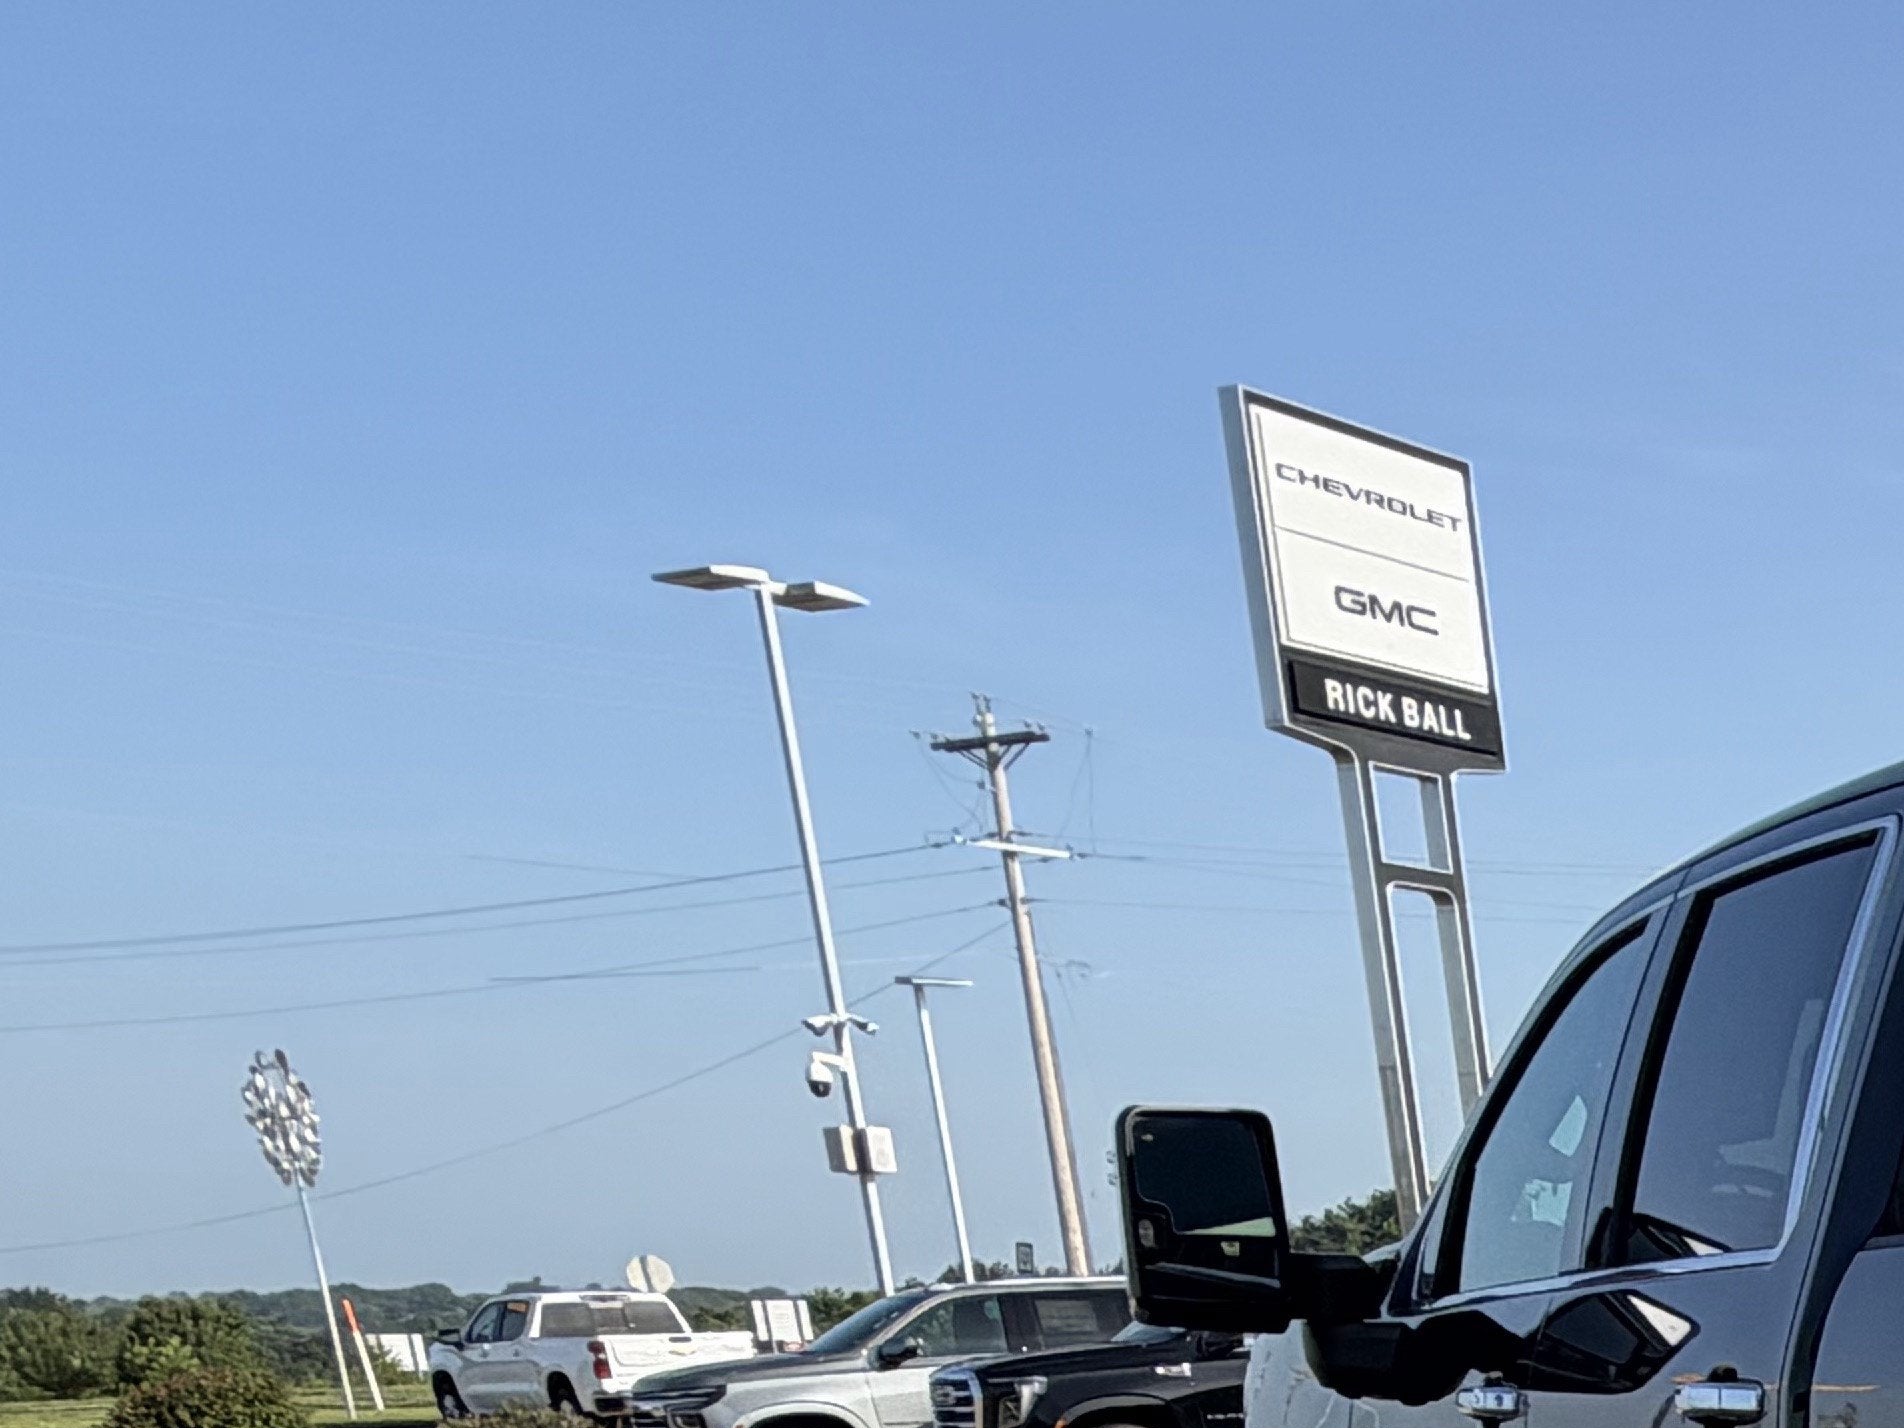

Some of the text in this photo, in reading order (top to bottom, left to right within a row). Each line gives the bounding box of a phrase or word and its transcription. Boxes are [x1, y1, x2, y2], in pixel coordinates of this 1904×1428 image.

[1275, 462, 1463, 533] CHEVROLET
[1334, 585, 1439, 636] GMC
[1324, 678, 1471, 741] RICK BALL
